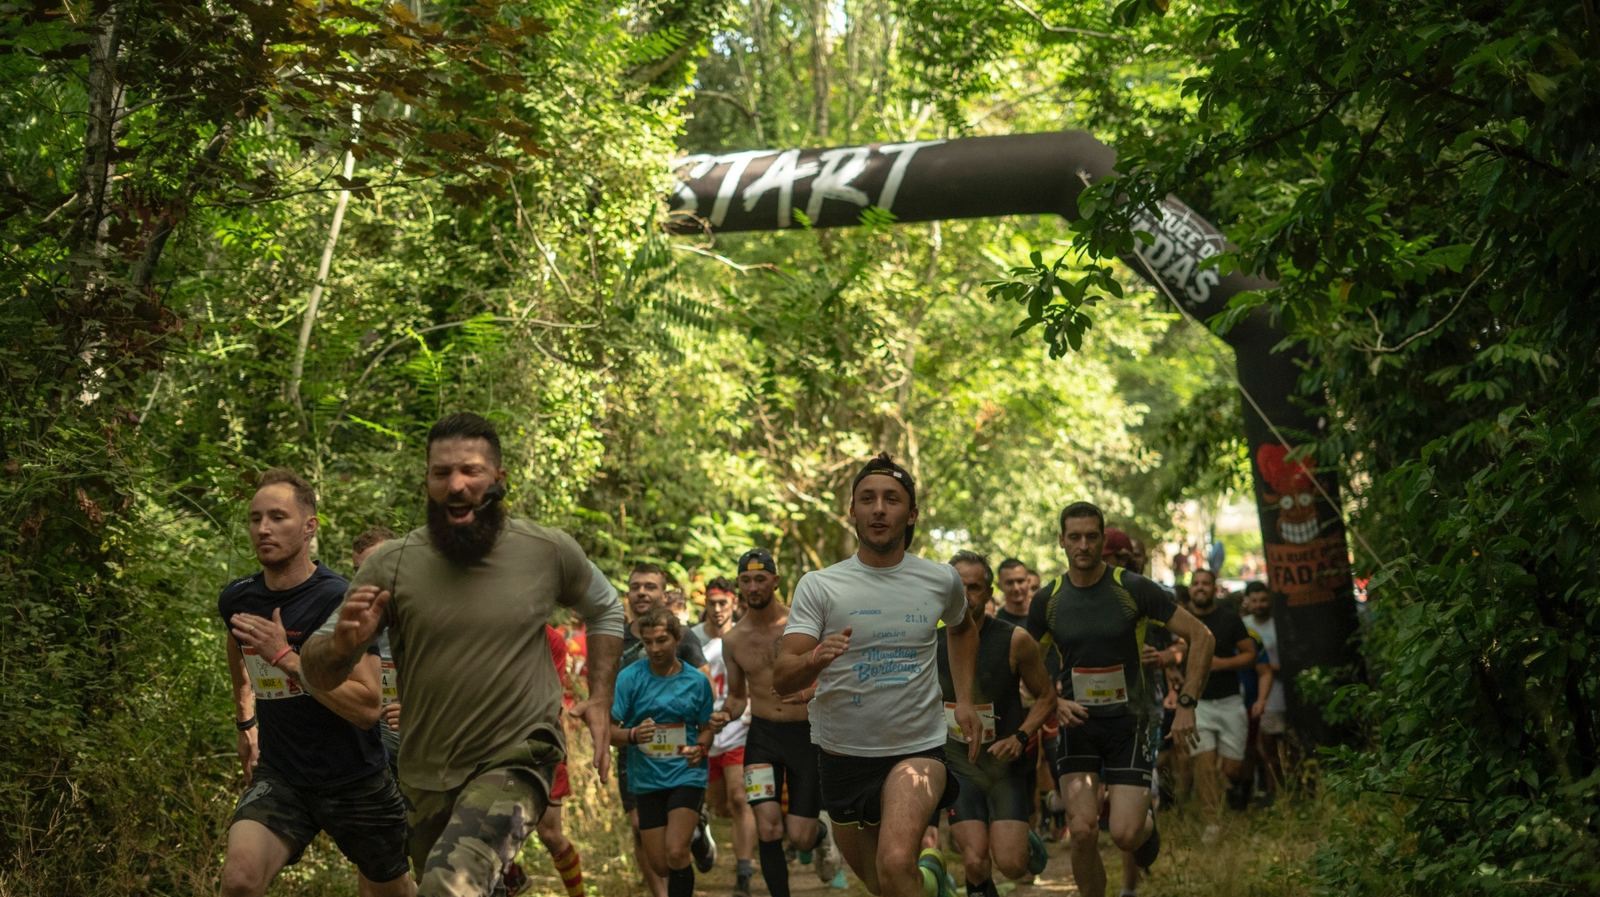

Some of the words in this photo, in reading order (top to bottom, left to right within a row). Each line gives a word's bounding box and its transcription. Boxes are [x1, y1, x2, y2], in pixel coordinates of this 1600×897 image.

[669, 139, 948, 228] START
[863, 647, 918, 661] Marathon
[656, 734, 667, 744] 31
